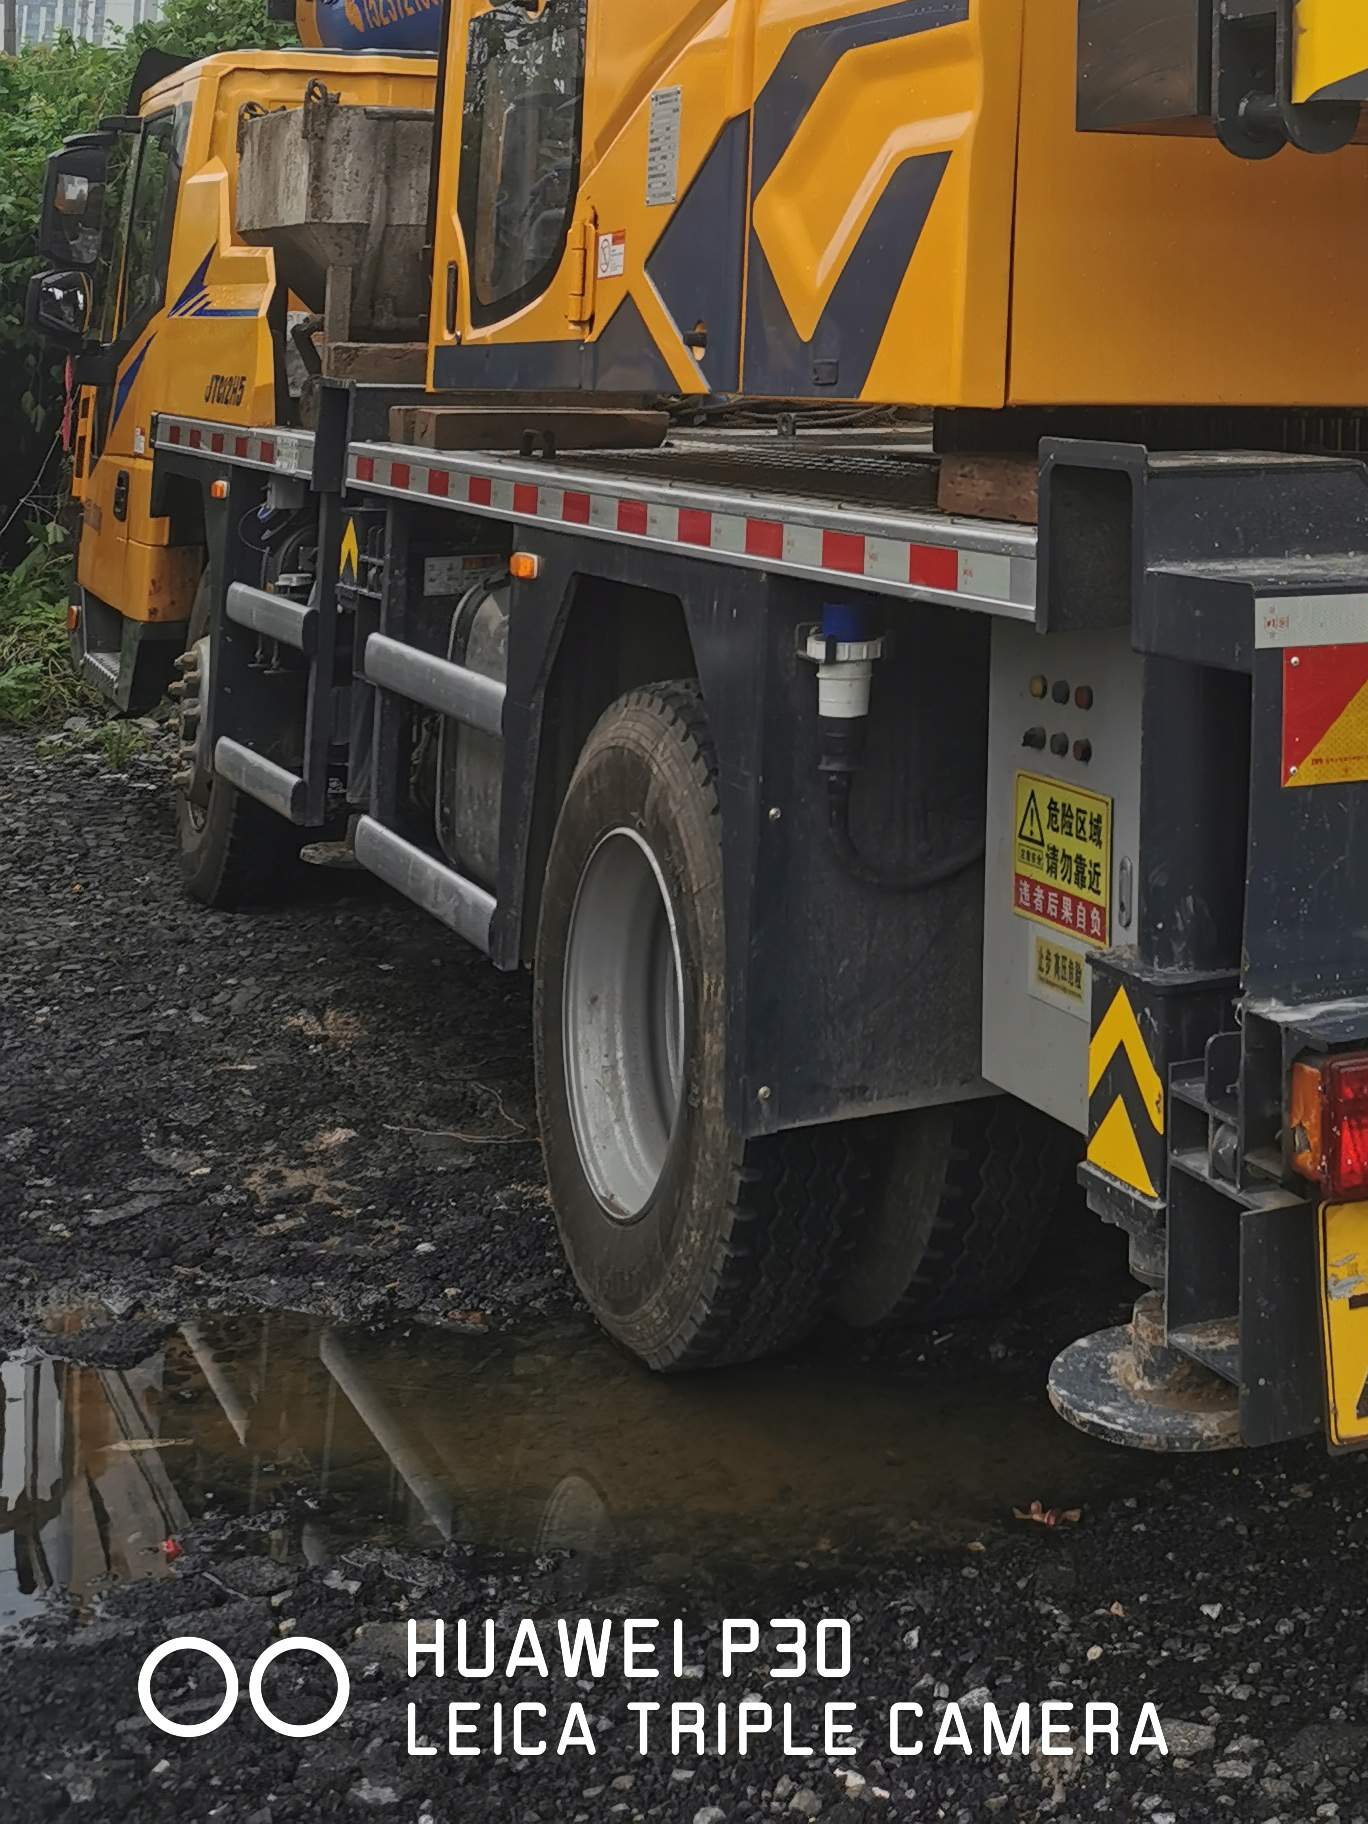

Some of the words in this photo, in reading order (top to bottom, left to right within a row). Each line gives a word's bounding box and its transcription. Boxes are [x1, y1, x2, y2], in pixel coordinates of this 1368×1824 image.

[1046, 796, 1103, 850] 危险区域
[1045, 842, 1101, 897] 请勿靠近
[1018, 879, 1101, 937] 违者后果自负
